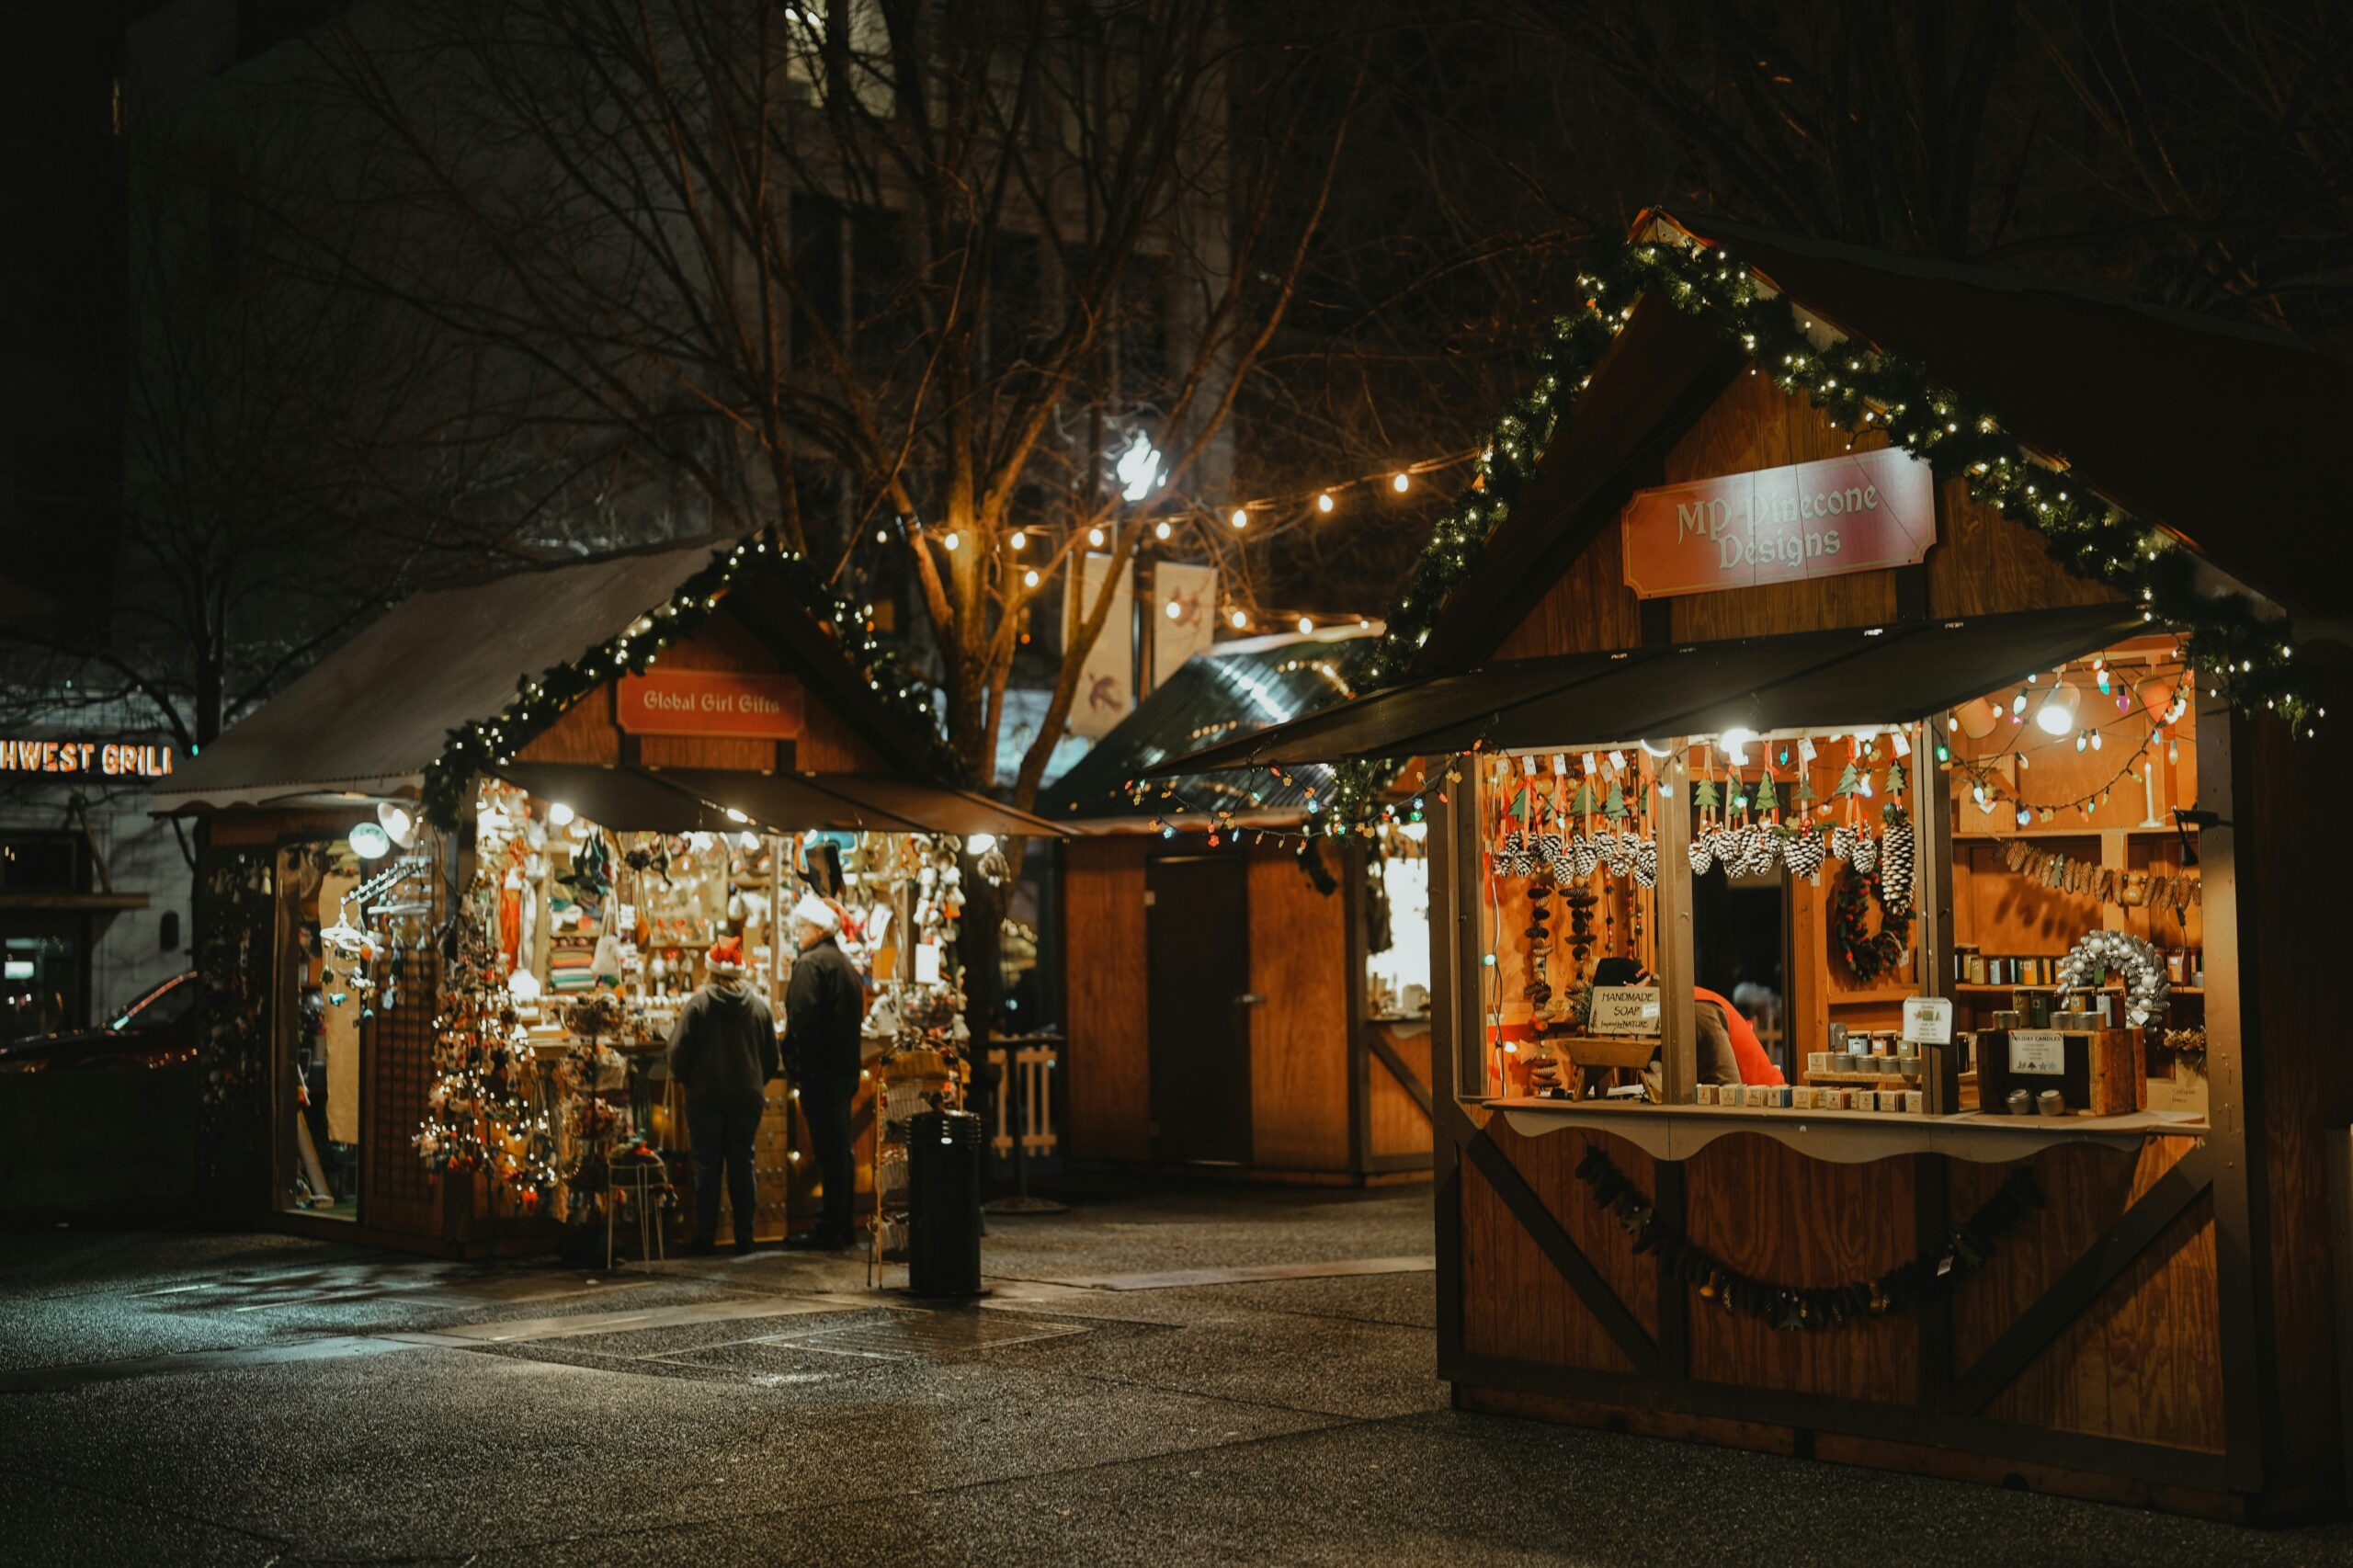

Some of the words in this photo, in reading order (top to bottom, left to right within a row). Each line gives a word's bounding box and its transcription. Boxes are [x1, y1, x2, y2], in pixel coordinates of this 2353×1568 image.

[1744, 484, 1879, 537] Pinecone
[1718, 528, 1841, 570] Designs
[643, 690, 695, 710] Global
[701, 693, 733, 712] Girl
[738, 695, 780, 713] Gifts
[0, 740, 95, 773] HWEST
[101, 743, 173, 776] GRILL
[1602, 992, 1654, 1003] HANDMADE
[1614, 1006, 1641, 1017] SOAP
[1622, 1020, 1649, 1028] NATURE
